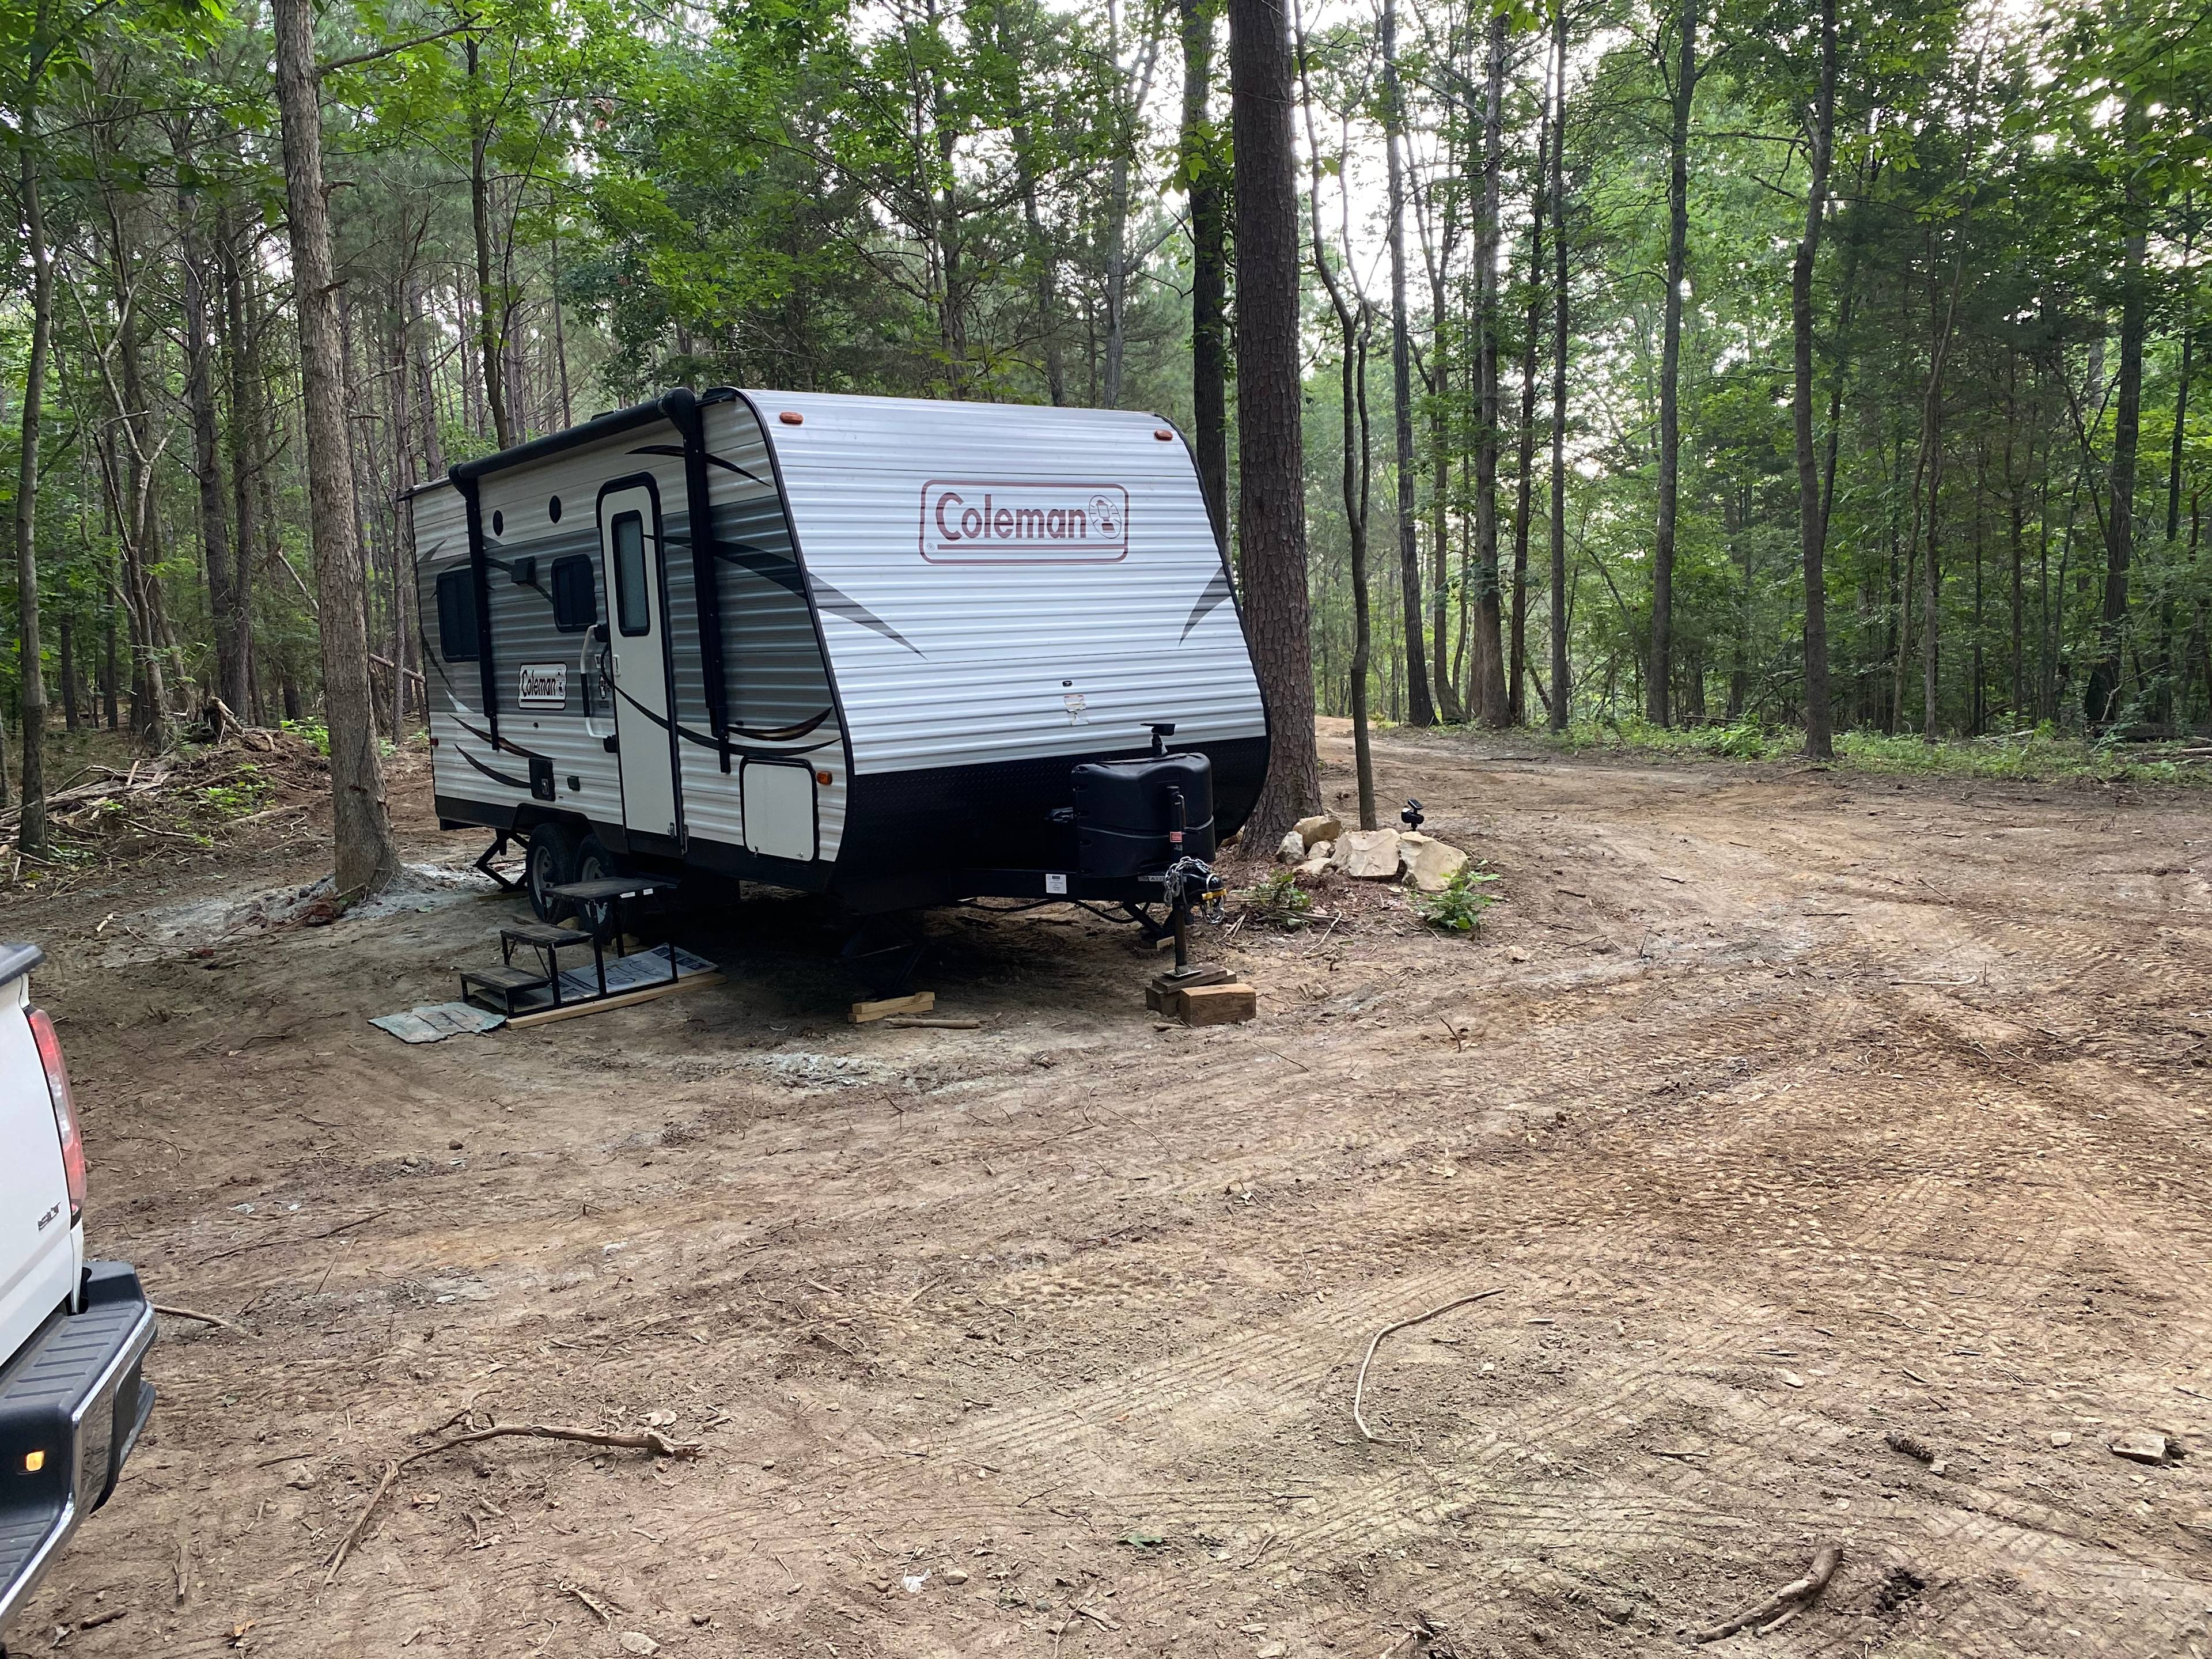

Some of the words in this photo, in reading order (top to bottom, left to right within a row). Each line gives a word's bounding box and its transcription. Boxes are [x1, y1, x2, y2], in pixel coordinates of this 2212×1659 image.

[935, 492, 1086, 541] Coleman
[521, 669, 556, 697] Coleman
[37, 1200, 60, 1232] SLT
